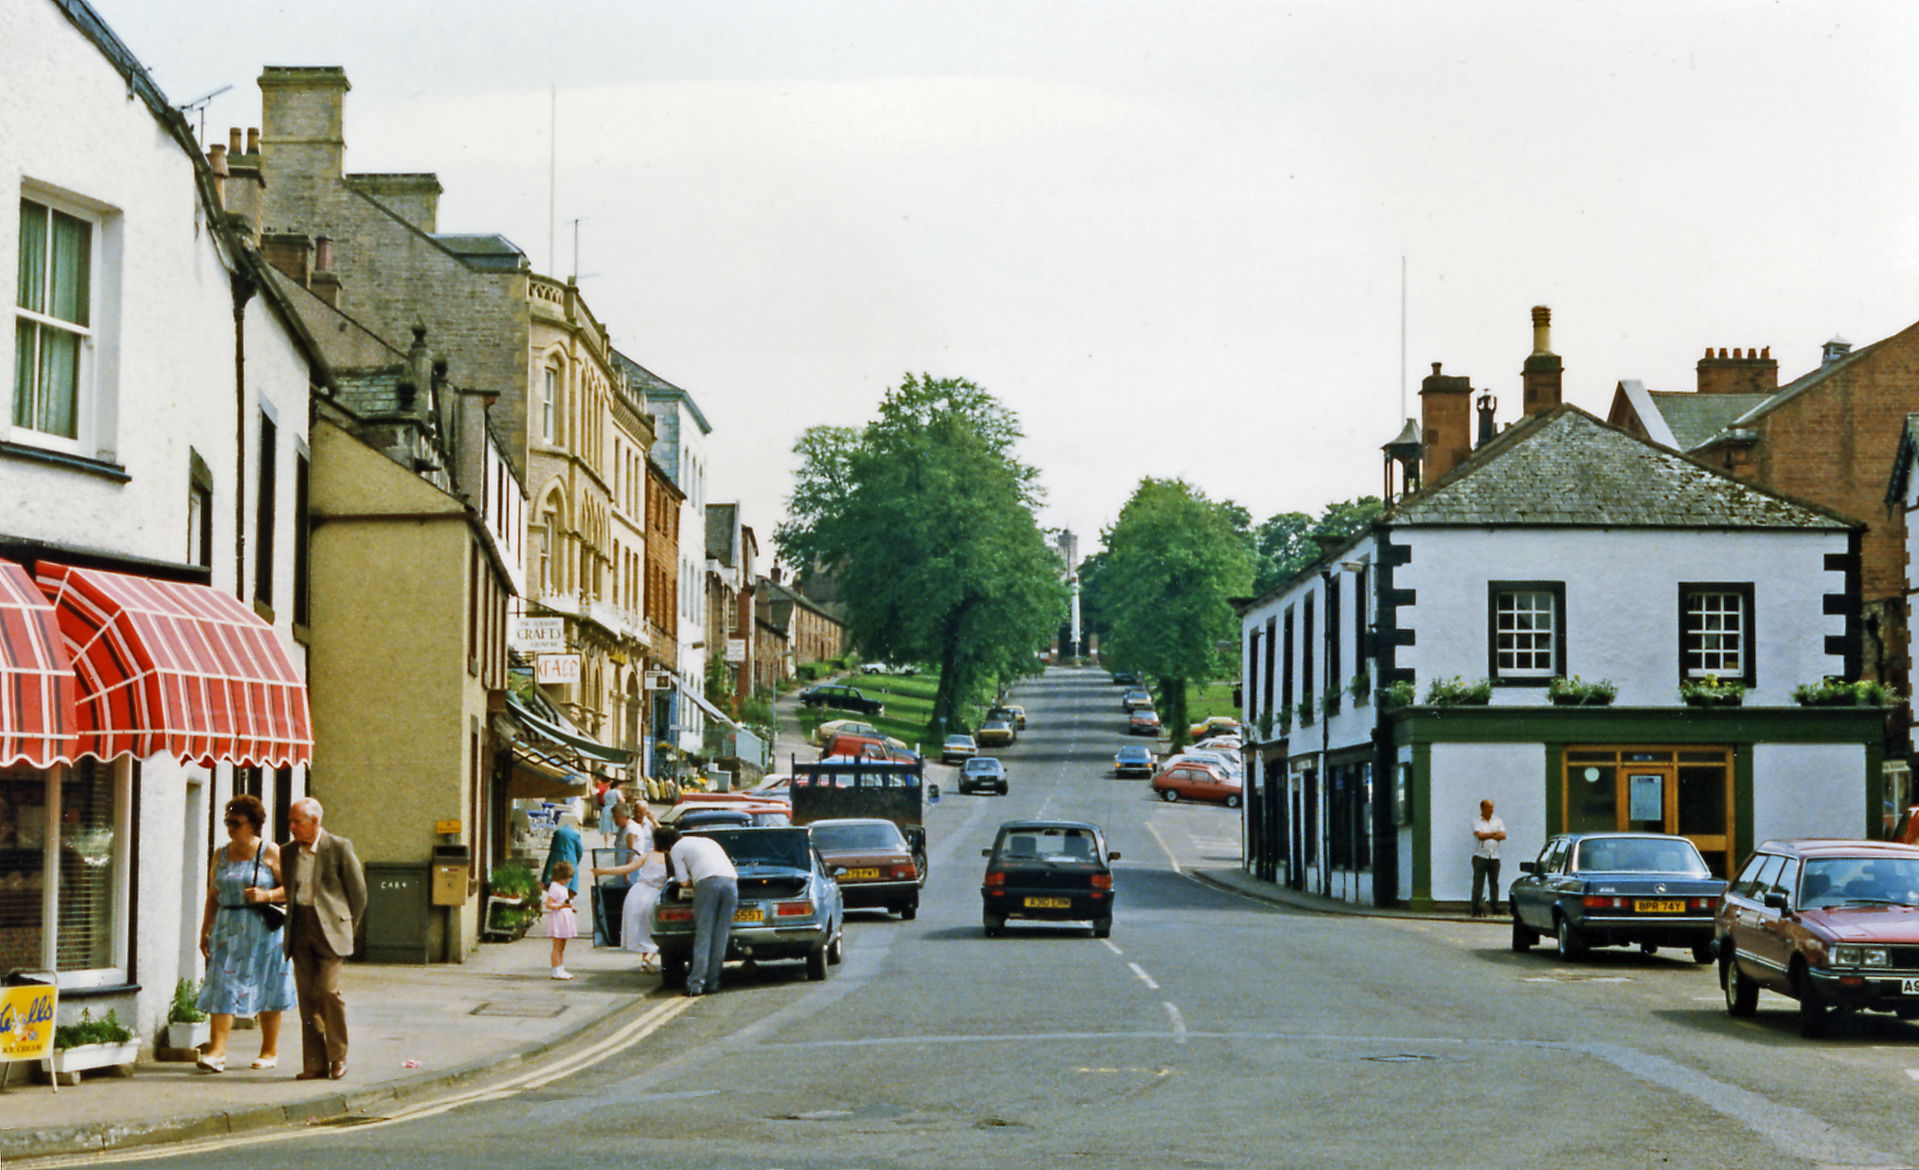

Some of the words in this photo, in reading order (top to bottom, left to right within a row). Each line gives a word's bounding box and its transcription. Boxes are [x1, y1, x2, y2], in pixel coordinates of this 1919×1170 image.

[517, 628, 561, 641] CRAFTS
[1638, 902, 1659, 911] BPR
[1662, 902, 1681, 911] 74Y
